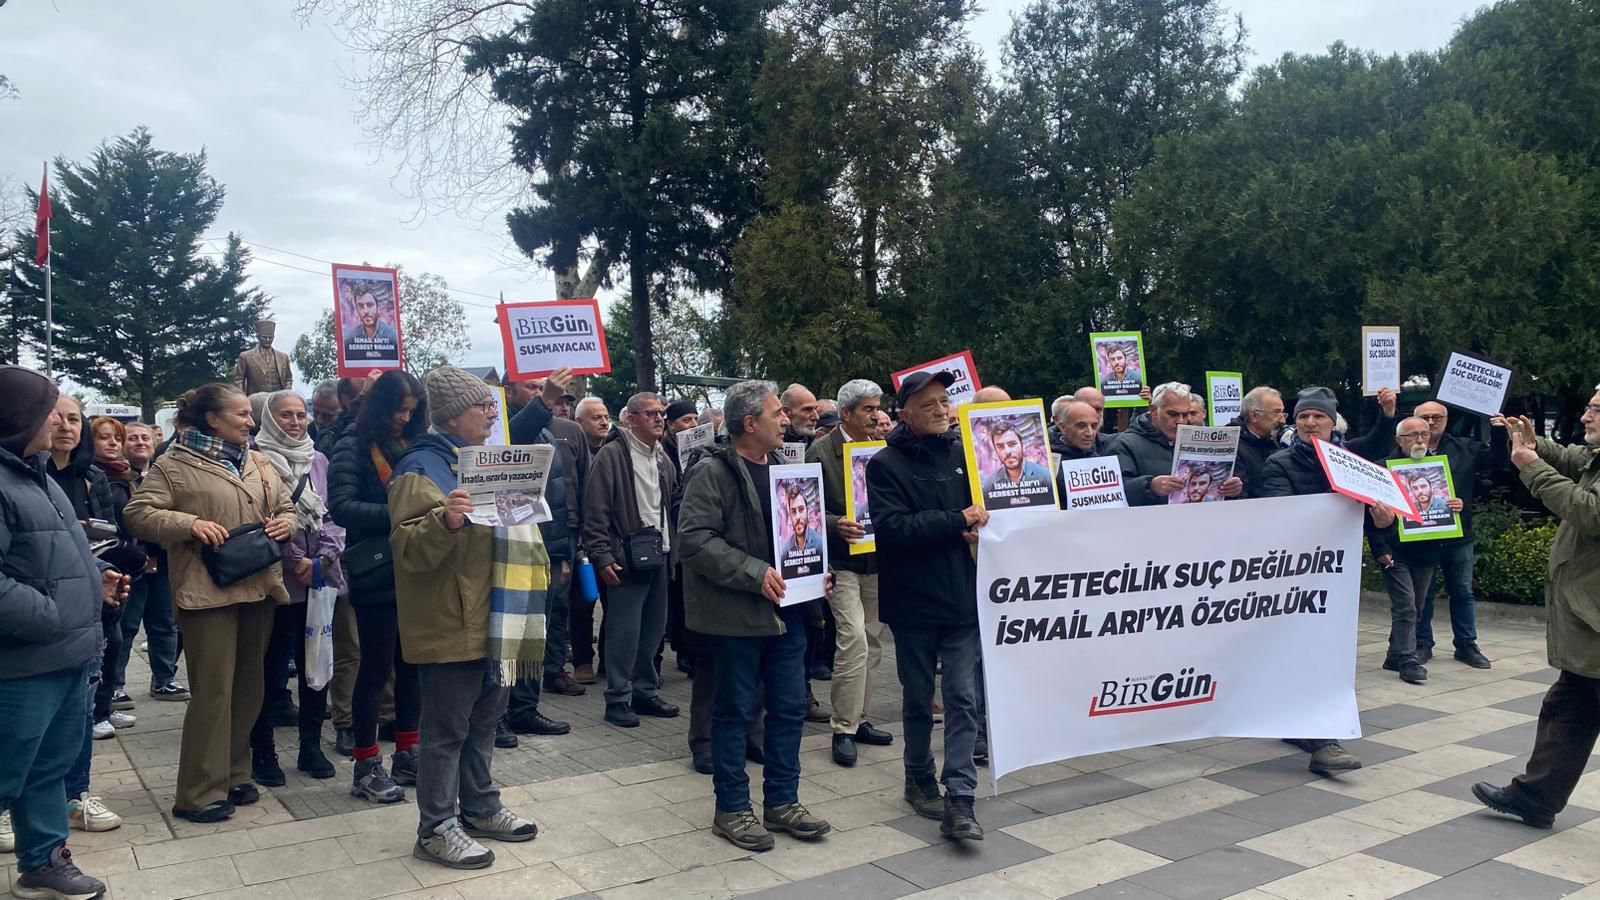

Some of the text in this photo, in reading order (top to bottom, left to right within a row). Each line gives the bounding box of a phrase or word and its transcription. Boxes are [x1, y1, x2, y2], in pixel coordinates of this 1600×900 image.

[519, 341, 597, 356] SUSMAYACAK!
[1456, 359, 1504, 380] GAZETECİLİK
[1450, 367, 1503, 390] SUÇ DEĞİLDİR!
[508, 470, 543, 483] yazacağız
[988, 486, 1048, 498] SERBEST BIRAKIN
[994, 481, 1018, 490] İSMAİL
[1071, 491, 1124, 508] SUSMAYACAK!
[989, 545, 1345, 604] GAZETECİLİK SUÇ DEĞİLDİR!
[995, 585, 1328, 646] İSMAİL ARI'YA ÖZGÜRLÜK!
